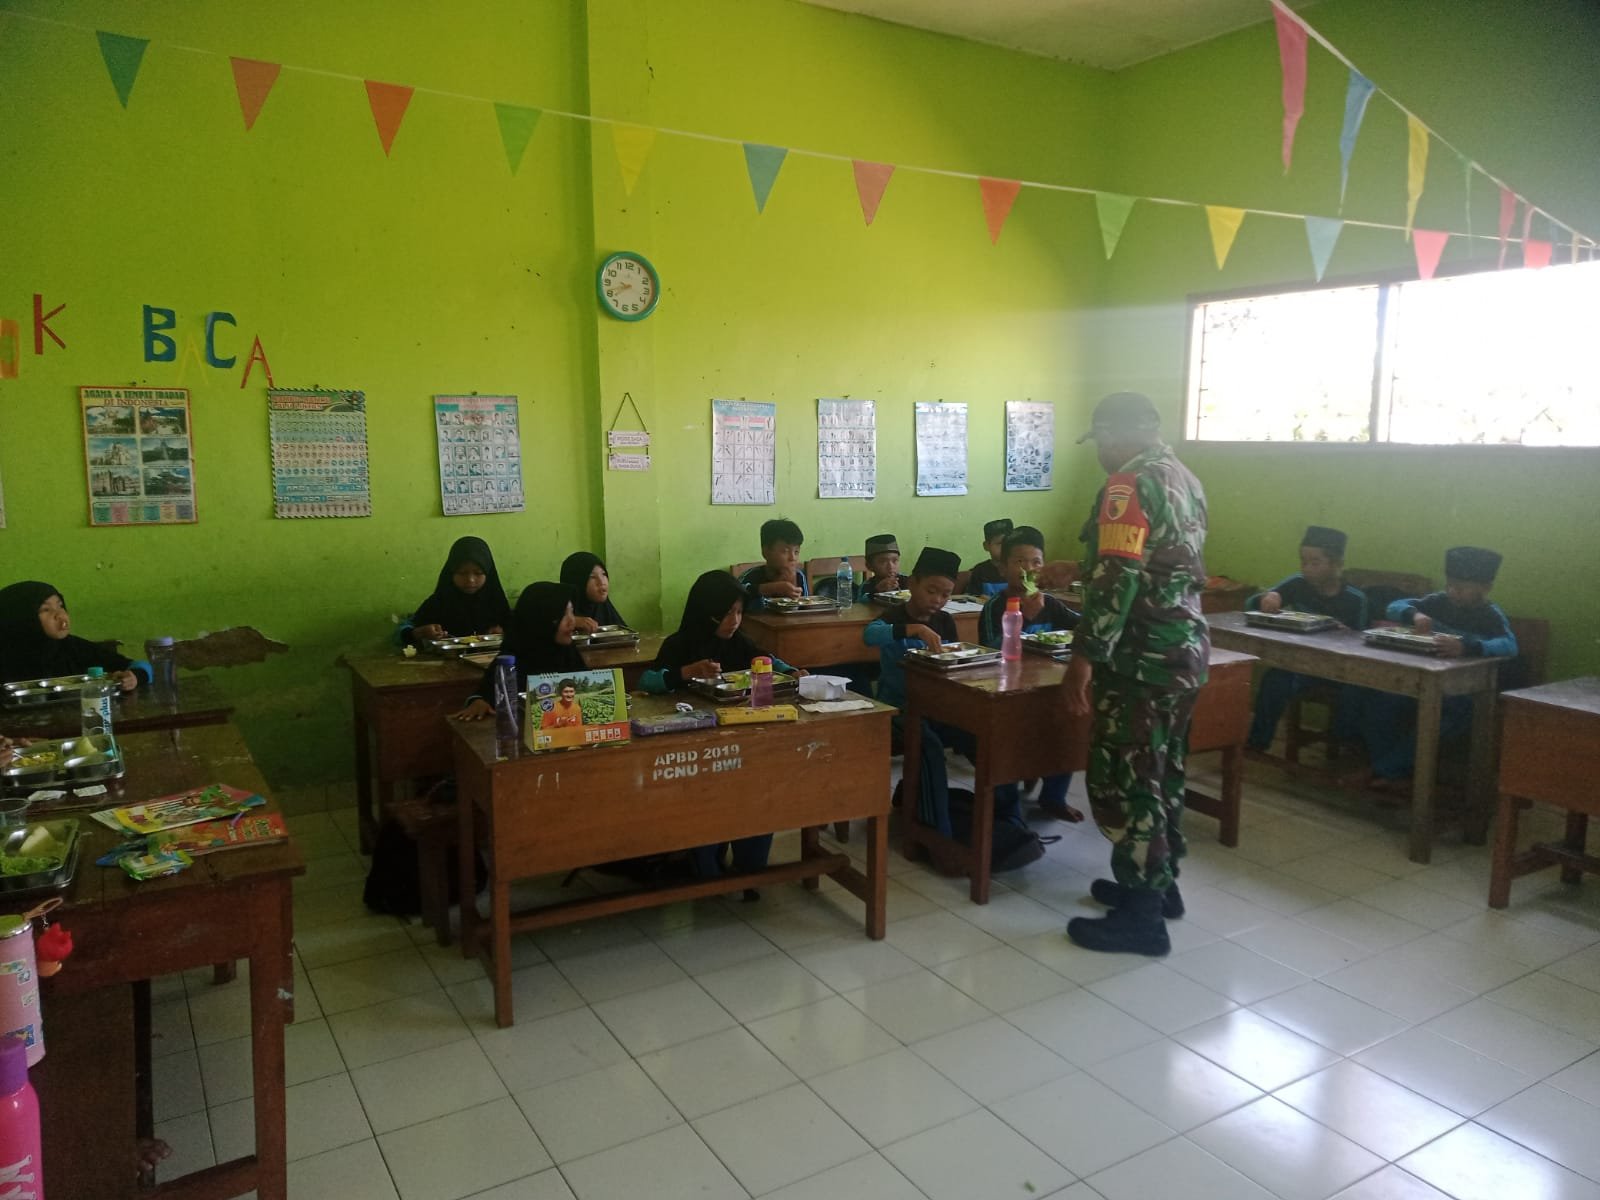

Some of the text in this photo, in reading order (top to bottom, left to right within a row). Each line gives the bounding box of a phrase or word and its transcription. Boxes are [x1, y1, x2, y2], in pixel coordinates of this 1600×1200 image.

[616, 262, 622, 270] 11
[625, 262, 634, 270] 12
[642, 277, 648, 285] 2
[613, 299, 618, 307] 7
[143, 304, 274, 389] BACA
[654, 744, 740, 766] APBD 2019
[653, 764, 698, 781] PCNU
